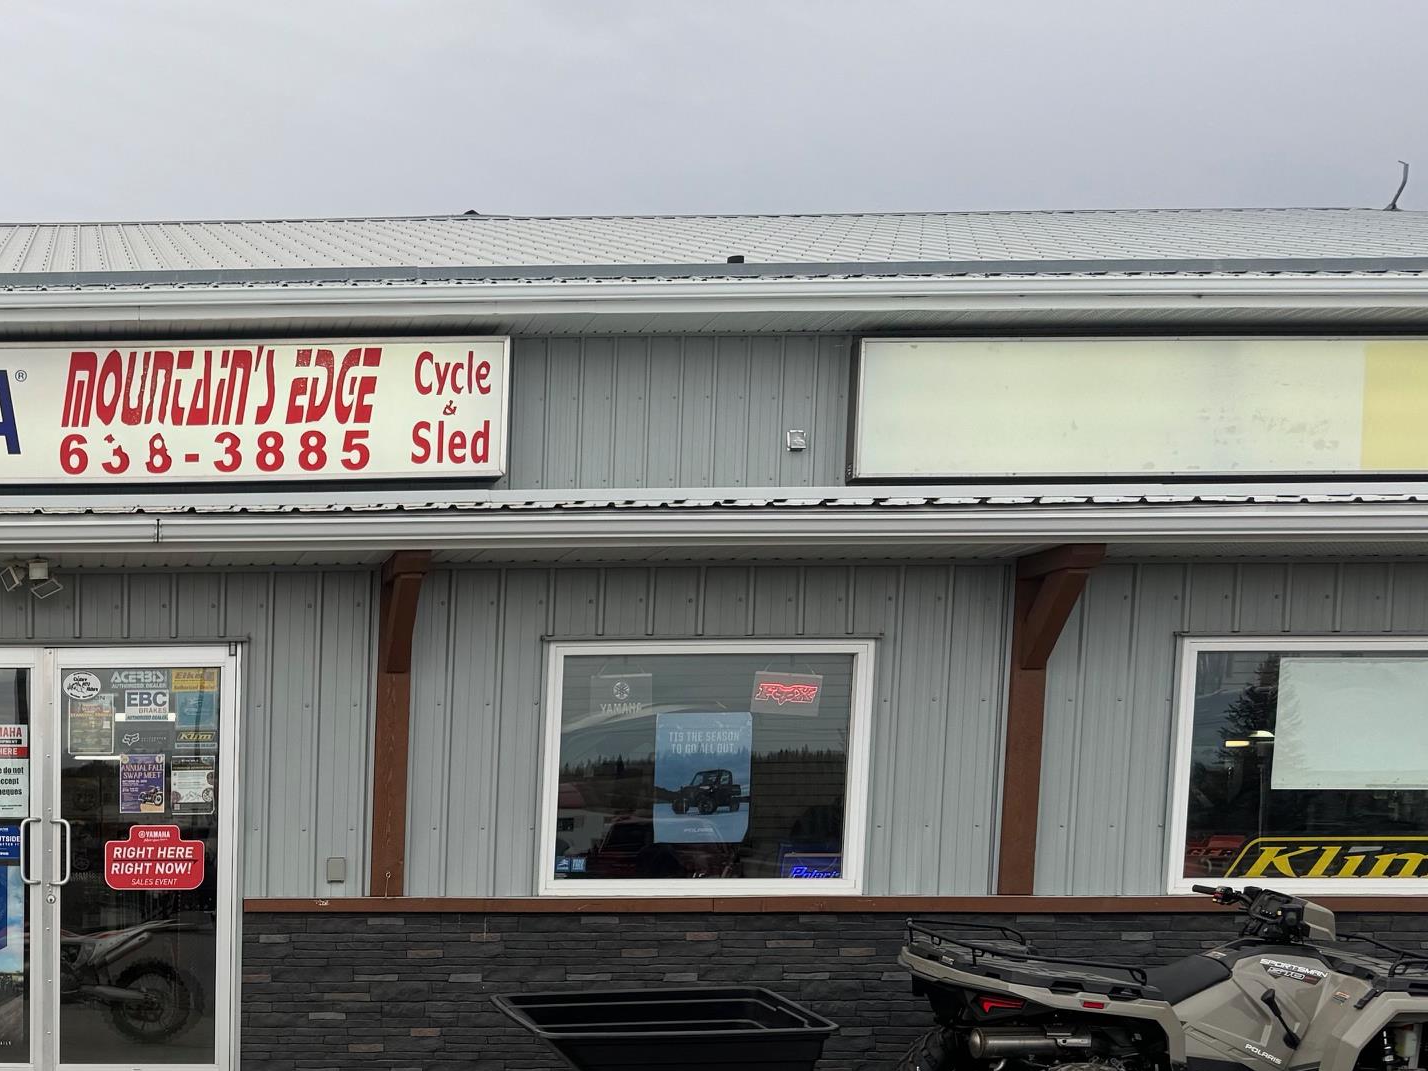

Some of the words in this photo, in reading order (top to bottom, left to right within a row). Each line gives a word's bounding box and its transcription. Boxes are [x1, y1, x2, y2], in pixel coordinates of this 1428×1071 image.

[414, 350, 492, 396] Cycle
[61, 346, 276, 428] MOUNTAIN'S
[285, 347, 383, 425] EDGE
[442, 399, 458, 416] &
[410, 419, 491, 464] Sled
[59, 430, 371, 475] 638-3885
[126, 691, 168, 708] EBC
[599, 702, 643, 715] YAMAHA
[179, 733, 212, 741] Klim
[686, 731, 703, 742] THE
[671, 743, 682, 754] TO
[3, 766, 12, 774] do
[12, 766, 24, 774] not
[145, 830, 171, 838] YAMAHA
[113, 847, 155, 859] RIGHT
[157, 846, 194, 858] HERE
[111, 862, 153, 875] RIGHT
[154, 862, 192, 875] NOW!
[131, 878, 154, 886] SALES
[154, 878, 178, 886] EVENT
[1259, 958, 1329, 978] SPORTSMAN
[1244, 1043, 1283, 1065] POLARIS
